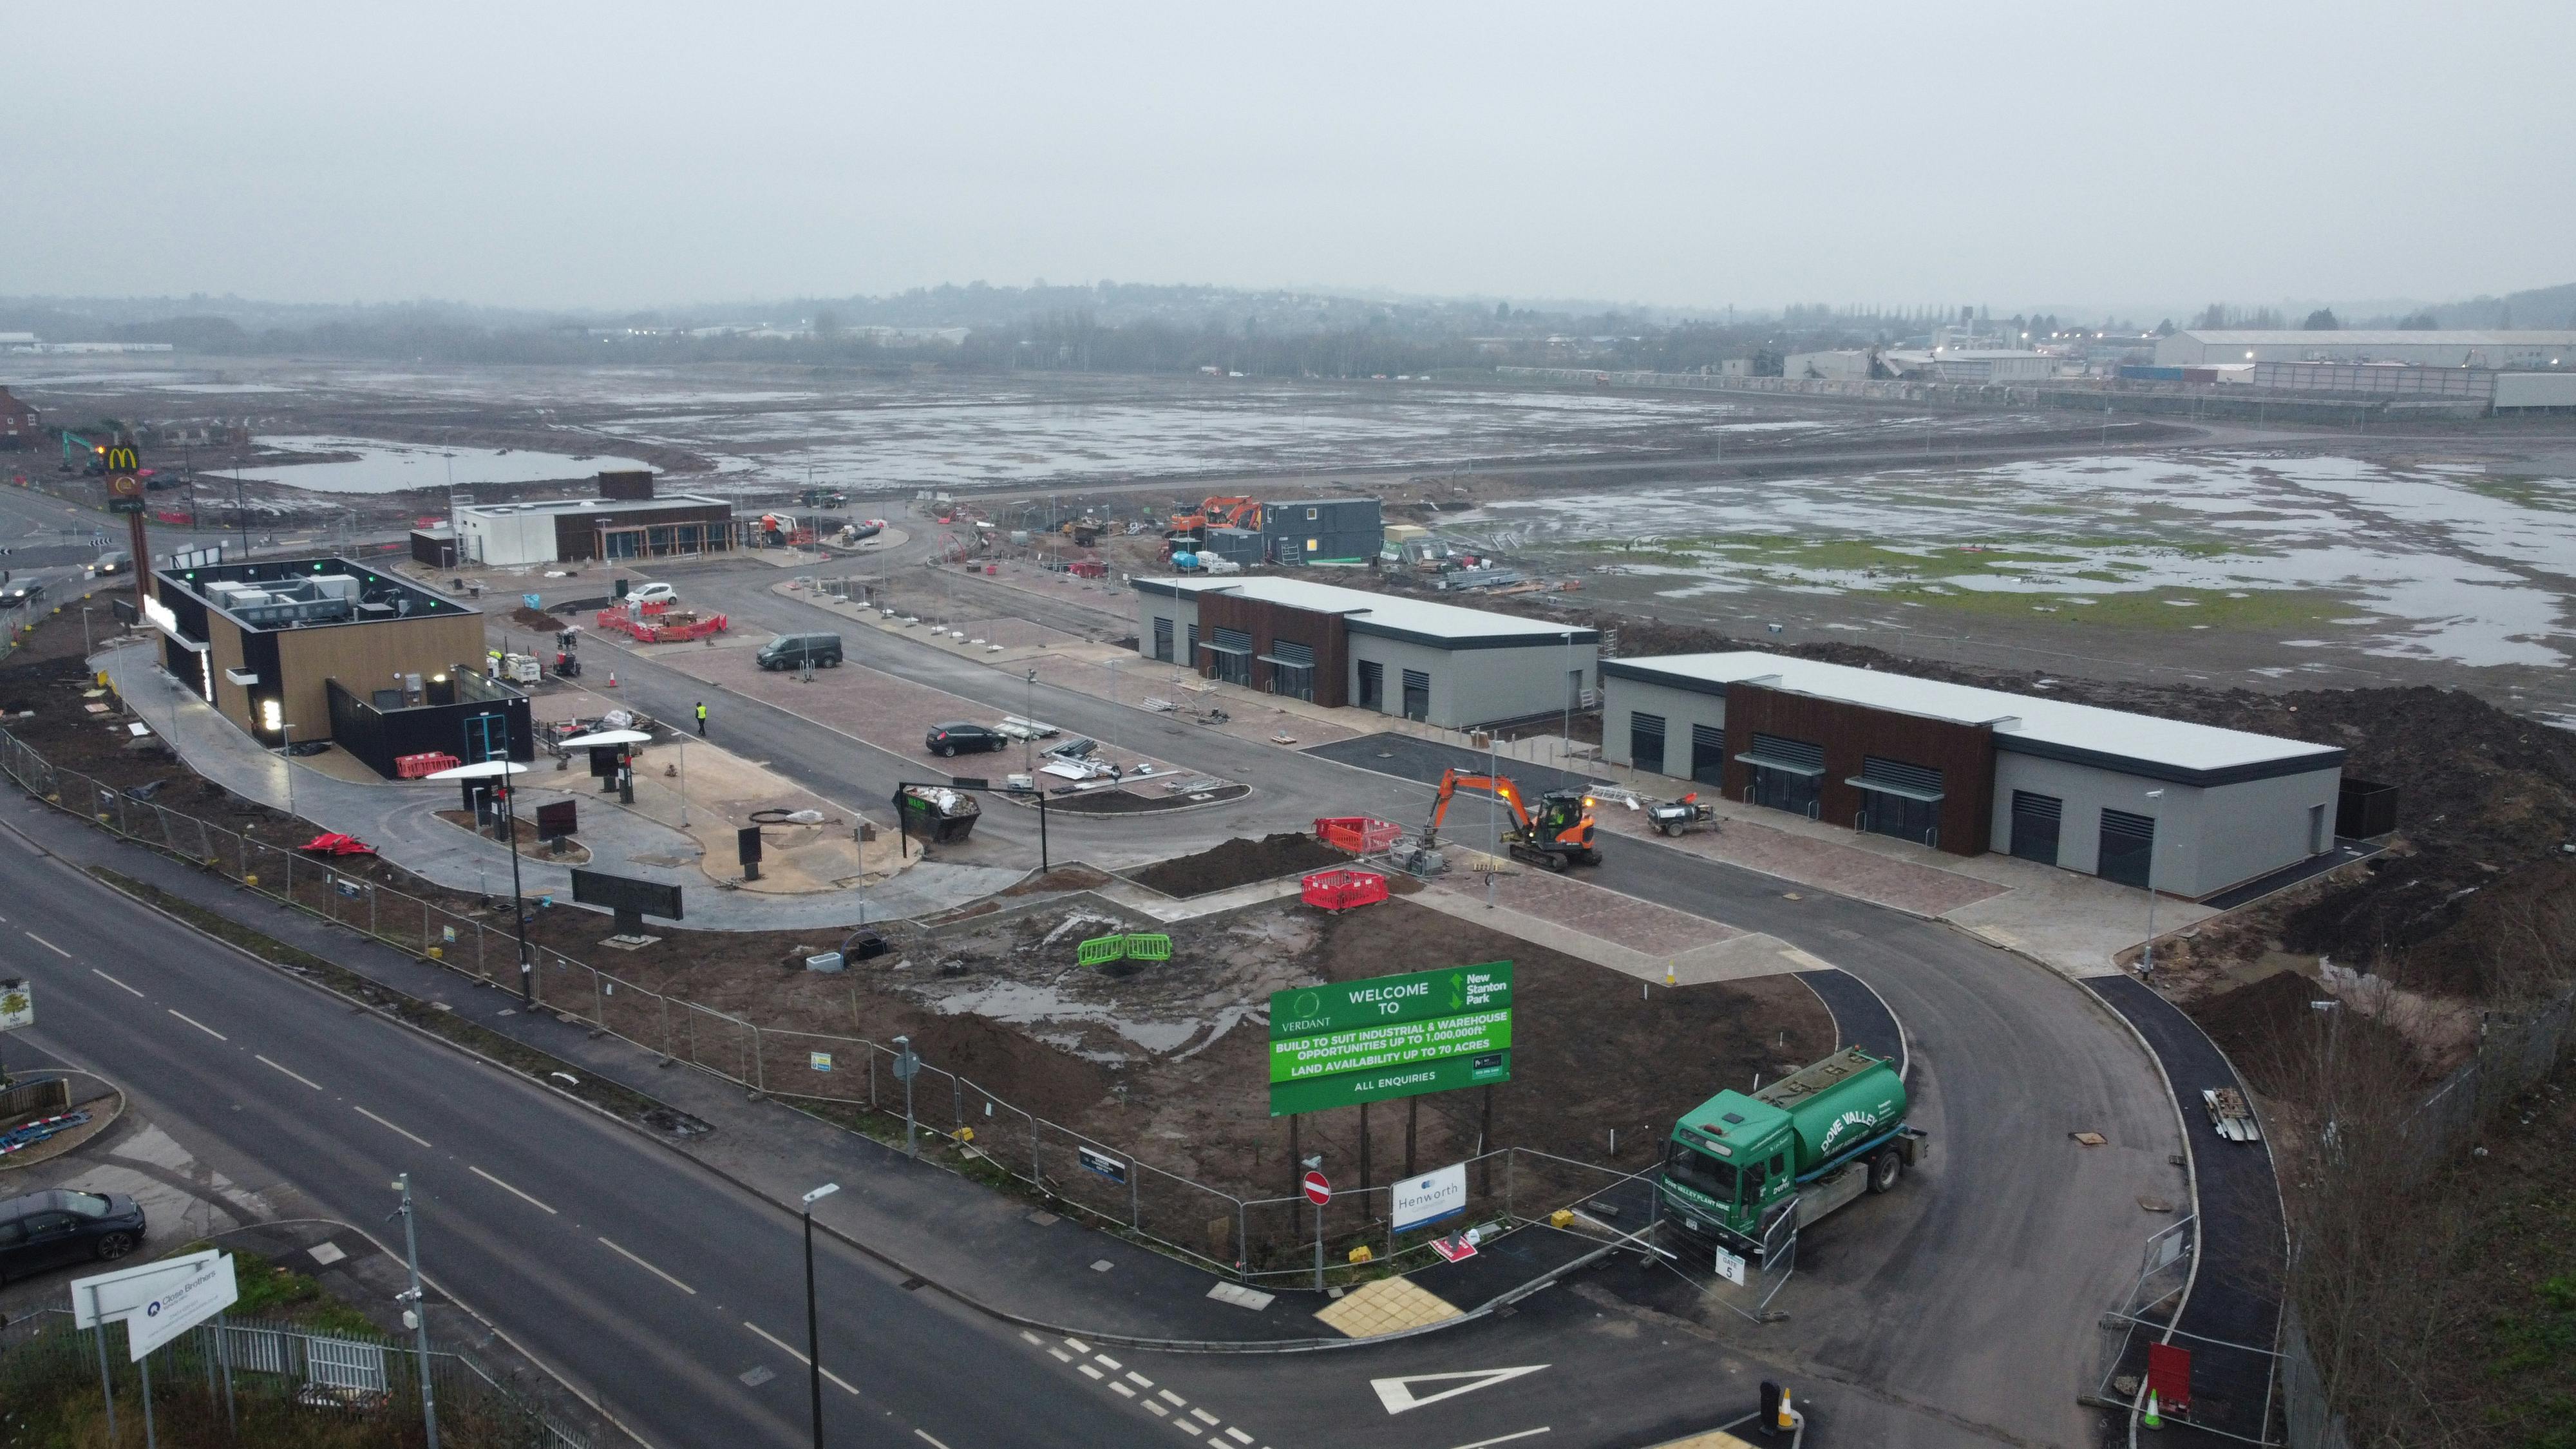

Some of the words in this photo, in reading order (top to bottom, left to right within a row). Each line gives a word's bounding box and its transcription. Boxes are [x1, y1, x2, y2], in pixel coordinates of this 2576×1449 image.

[907, 797, 925, 810] WARD
[1467, 974, 1490, 984] New
[1467, 982, 1506, 994] Stanton
[1349, 982, 1428, 1003] WELCOME
[1466, 994, 1490, 1005] Park
[1378, 1001, 1399, 1015] TO
[1276, 1040, 1310, 1053] BUILD
[1312, 1037, 1329, 1047] TO
[1331, 1033, 1356, 1045] SUIT
[1359, 1024, 1425, 1041] INDUSTRIAL
[1428, 1023, 1435, 1031] &
[1437, 1012, 1508, 1030] WAREHOUSE
[1282, 1017, 1331, 1032] VERDANT
[1291, 1064, 1322, 1076] LAND
[1325, 1052, 1401, 1072] AVAILABILITY
[1403, 1050, 1418, 1059] UP
[1421, 1047, 1435, 1057] TO
[1438, 1045, 1452, 1054] 70
[1454, 1039, 1490, 1052] ACRES
[1297, 1039, 1387, 1060] OPPORTUNITIES
[1389, 1036, 1405, 1047] UP
[1407, 1035, 1423, 1045] TO
[1354, 1081, 1374, 1092] ALL
[1378, 1072, 1435, 1088] ENQUIRIES
[1821, 1119, 1844, 1152] DOVE
[1842, 1111, 1877, 1128] VALLEY
[1399, 1182, 1458, 1209] Henworth
[1665, 1179, 1677, 1189] DOVE
[1677, 1185, 1696, 1198] VALLEY
[1697, 1195, 1716, 1207] PLANT
[1716, 1202, 1730, 1211] HIRE
[1723, 1257, 1738, 1269] GATE
[1727, 1267, 1732, 1278] 5
[162, 1289, 184, 1305] Close
[185, 1270, 216, 1293] Brothers
